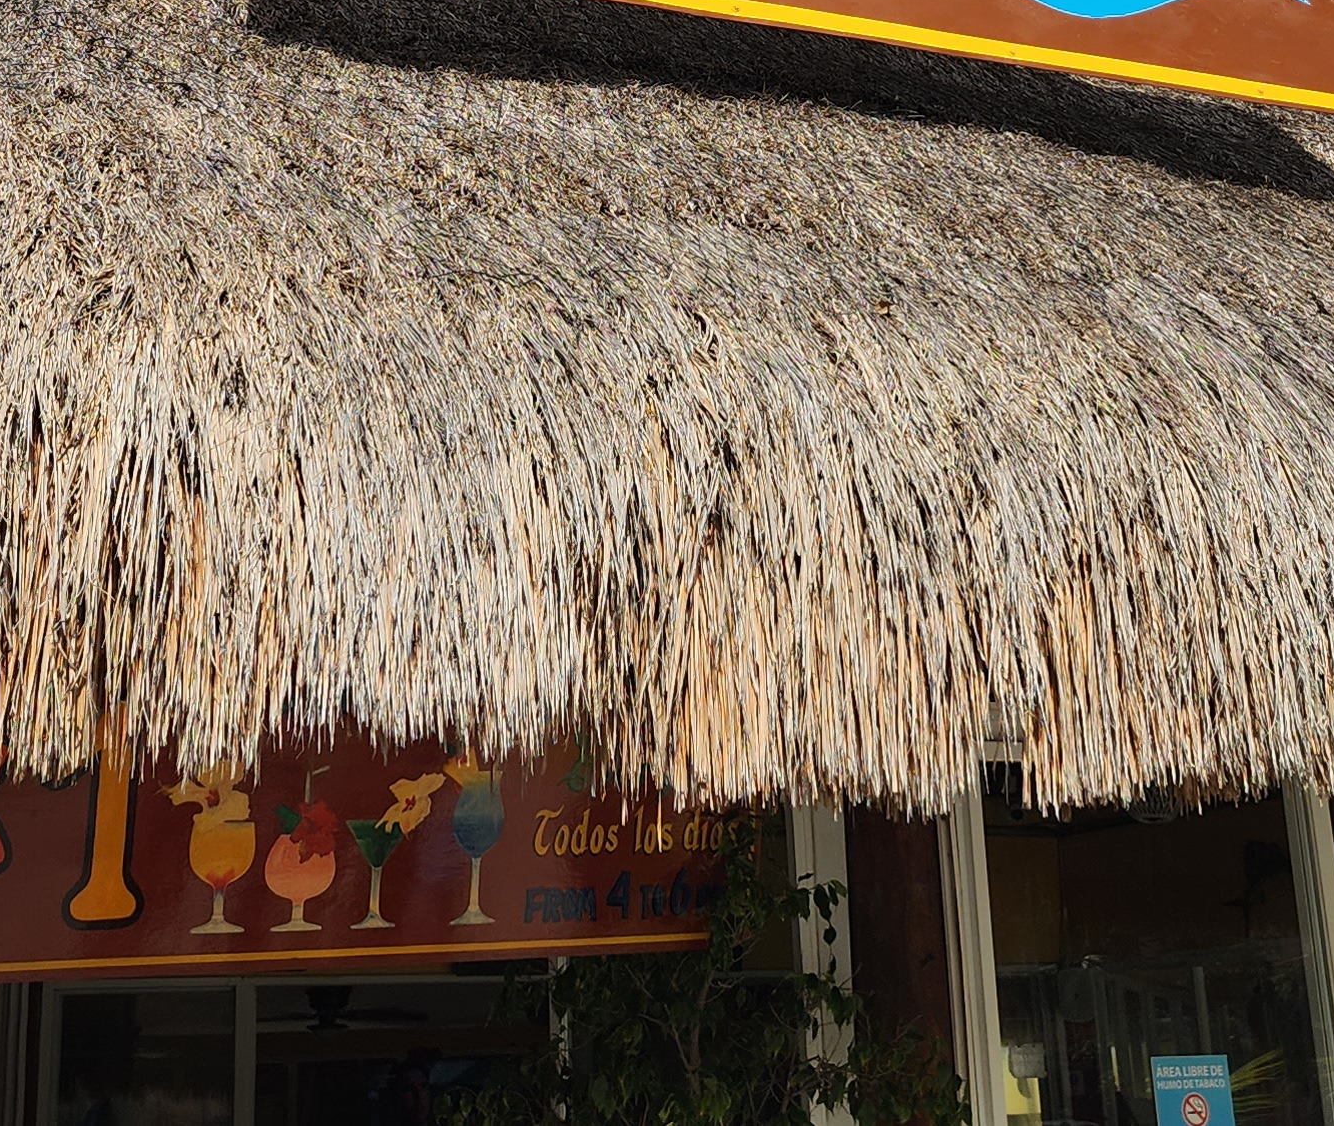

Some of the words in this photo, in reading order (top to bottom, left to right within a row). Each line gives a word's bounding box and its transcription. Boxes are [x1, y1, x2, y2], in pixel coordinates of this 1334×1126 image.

[532, 804, 620, 857] Todos
[632, 804, 674, 856] los
[524, 886, 597, 923] FROM
[605, 870, 632, 920] 4
[639, 882, 666, 921] TO
[669, 866, 692, 917] 6
[1156, 1063, 1181, 1077] ÁREA
[1183, 1065, 1209, 1077] LIBRE
[1210, 1065, 1224, 1076] DE
[1157, 1079, 1182, 1090] HUMO
[1183, 1079, 1194, 1089] DE
[1194, 1078, 1225, 1089] TABACO
